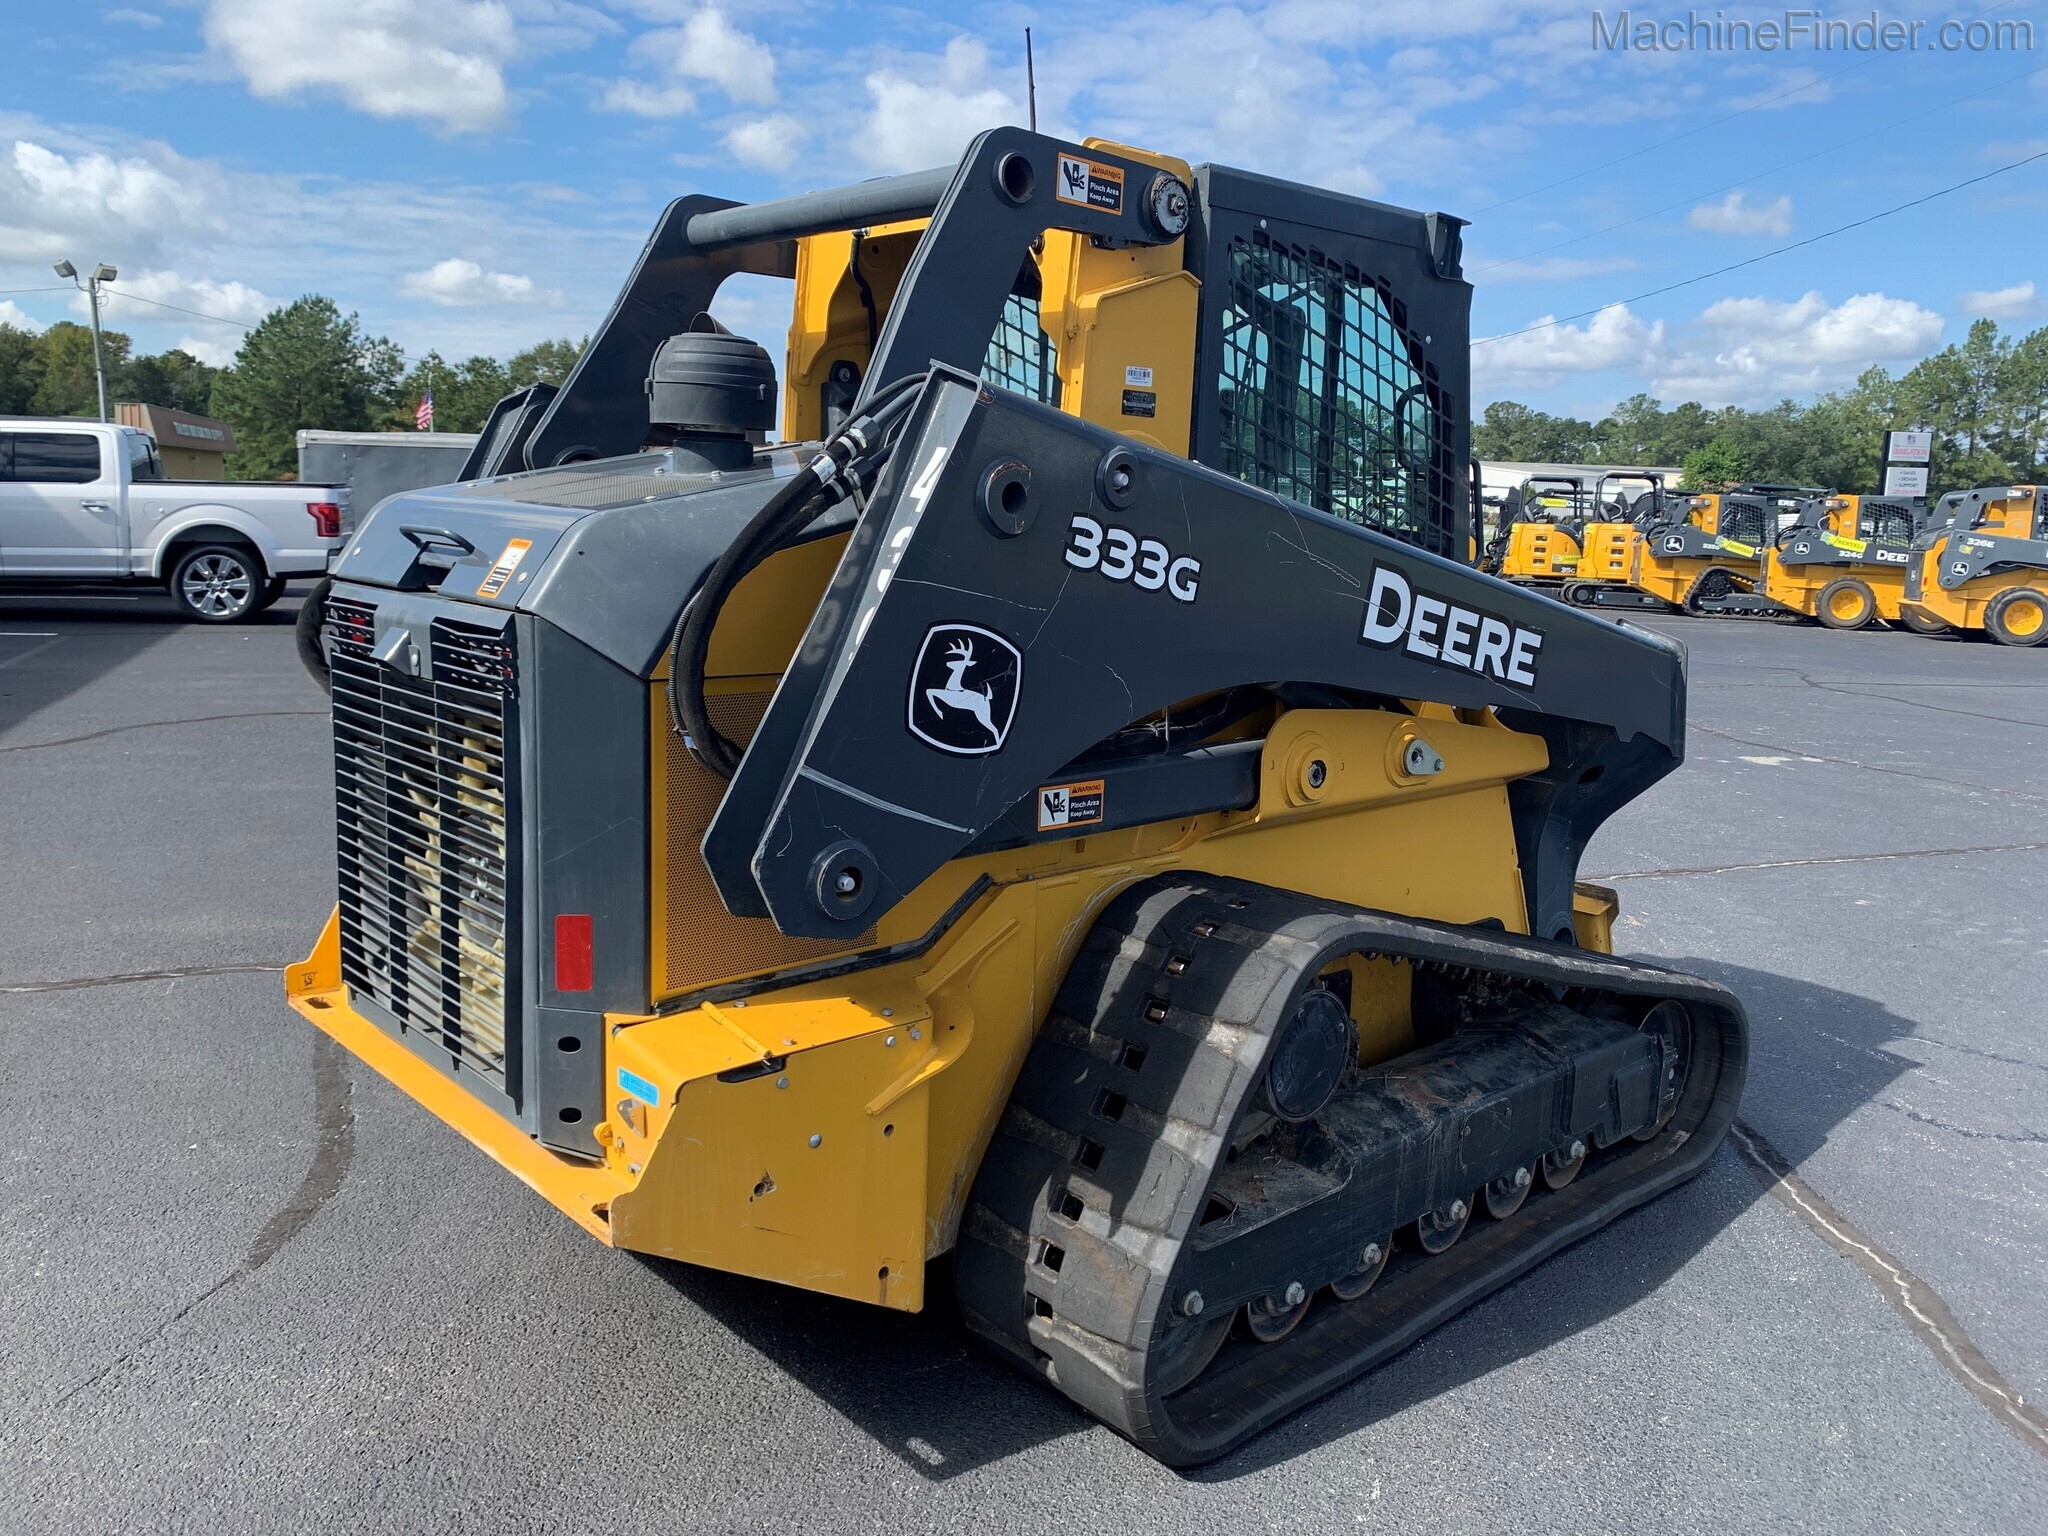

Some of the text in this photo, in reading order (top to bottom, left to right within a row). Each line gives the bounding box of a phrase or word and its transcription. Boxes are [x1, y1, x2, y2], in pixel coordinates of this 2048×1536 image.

[1097, 167, 1121, 179] WARNING
[1090, 182, 1119, 196] Pinch Area
[1089, 192, 1115, 205] Keep Away
[1966, 537, 1996, 548] 326E
[1065, 516, 1201, 602] 333G
[1838, 550, 1864, 559] 324G
[1362, 566, 1543, 687] DEERE
[1077, 784, 1102, 793] WARNING
[1070, 799, 1100, 809] Pinch Area
